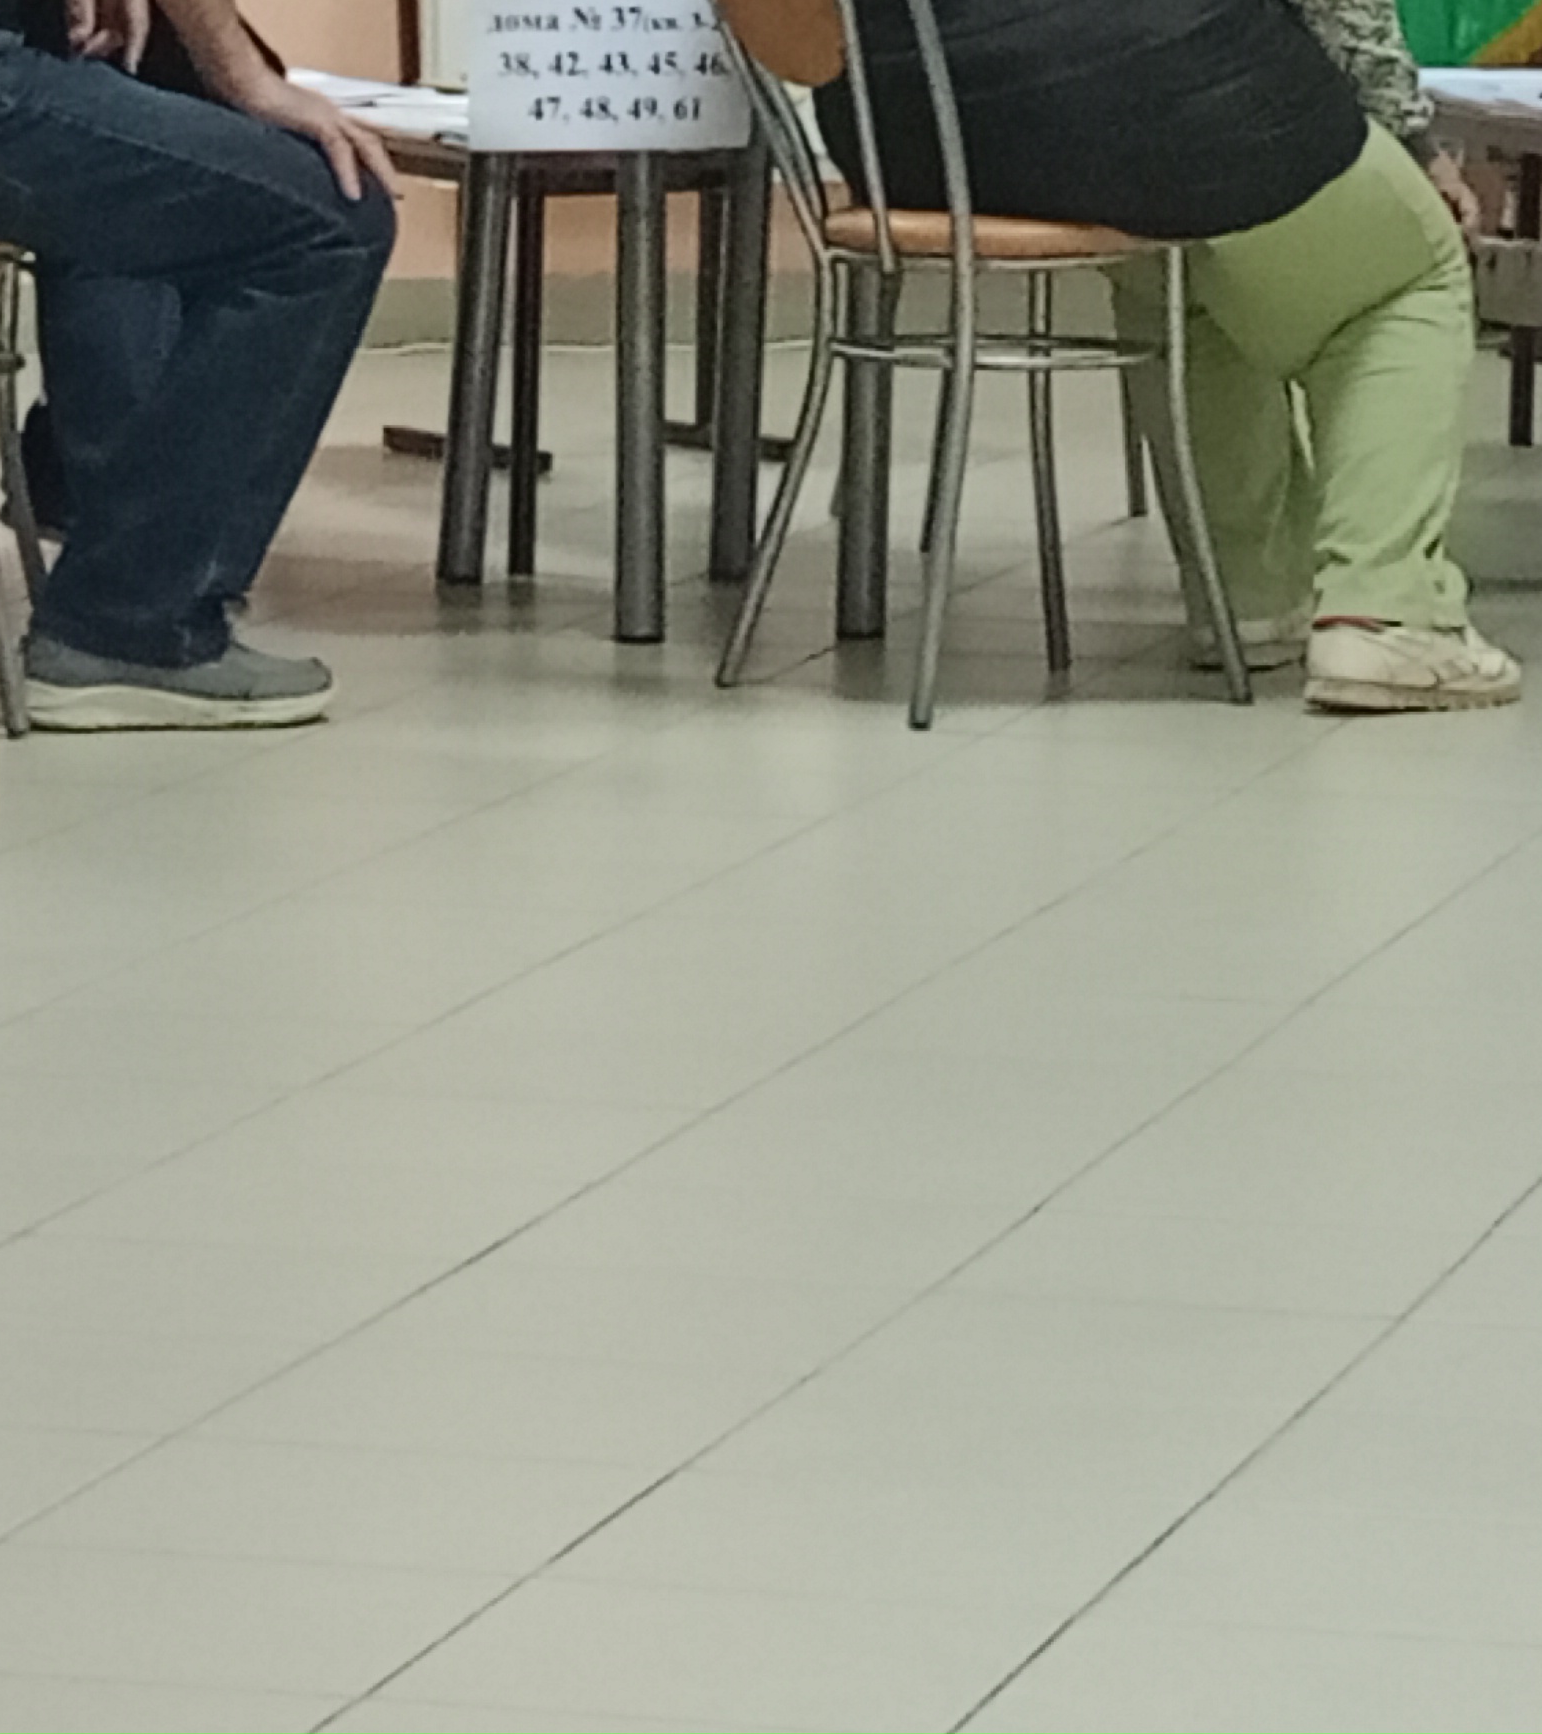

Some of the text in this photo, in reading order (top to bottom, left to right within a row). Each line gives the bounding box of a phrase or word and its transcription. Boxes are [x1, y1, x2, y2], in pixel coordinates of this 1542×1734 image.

[487, 14, 559, 33] дома
[569, 7, 602, 32] №
[498, 51, 540, 79] 38,
[549, 51, 589, 78] 42,
[600, 51, 639, 78] 43,
[647, 50, 687, 79] 45,
[528, 96, 701, 124] 47, 48, 49, 61
